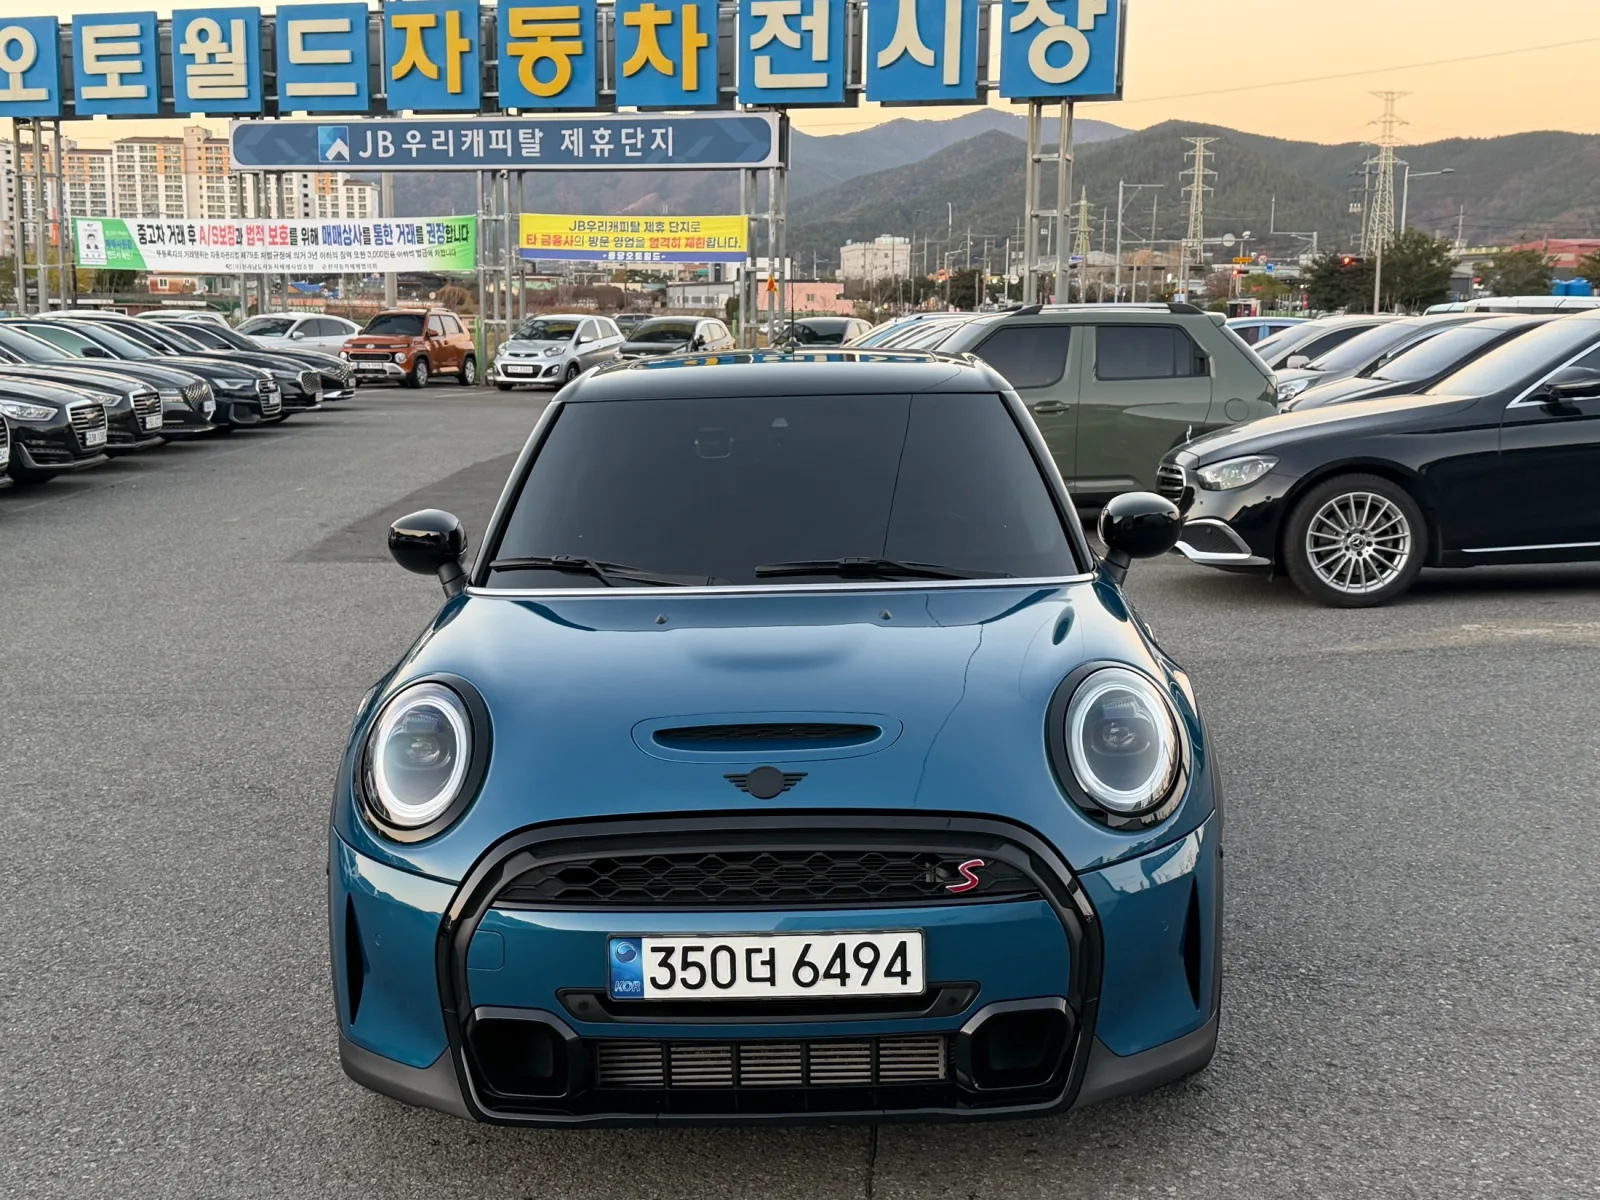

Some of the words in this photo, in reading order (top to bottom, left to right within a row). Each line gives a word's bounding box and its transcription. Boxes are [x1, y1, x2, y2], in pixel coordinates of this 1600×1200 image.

[358, 128, 543, 158] JB우리캐피탈
[560, 126, 673, 157] 제휴단지
[137, 224, 165, 245] 중고차
[167, 224, 186, 246] 거래
[187, 224, 197, 246] 후
[200, 224, 243, 247] A/S보장과
[246, 224, 265, 247] 법적
[268, 224, 298, 246] 보호를
[301, 227, 319, 246] 위해
[322, 224, 372, 246] 매매상사를
[373, 223, 393, 246] 통한
[395, 223, 424, 246] 거래를
[426, 222, 469, 245] 권장합니다
[569, 221, 641, 233] JB우리캐피탈
[643, 221, 665, 233] 제휴
[668, 221, 701, 233] 단지로
[526, 234, 538, 246] 타
[541, 235, 585, 247] 금융사의
[588, 236, 609, 248] 방문
[613, 236, 645, 248] 영업을
[649, 237, 681, 249] 엄격히
[684, 237, 741, 249] 제한합니다.
[649, 944, 776, 990] 350더
[792, 940, 912, 988] 6494
[614, 980, 642, 993] KOR
